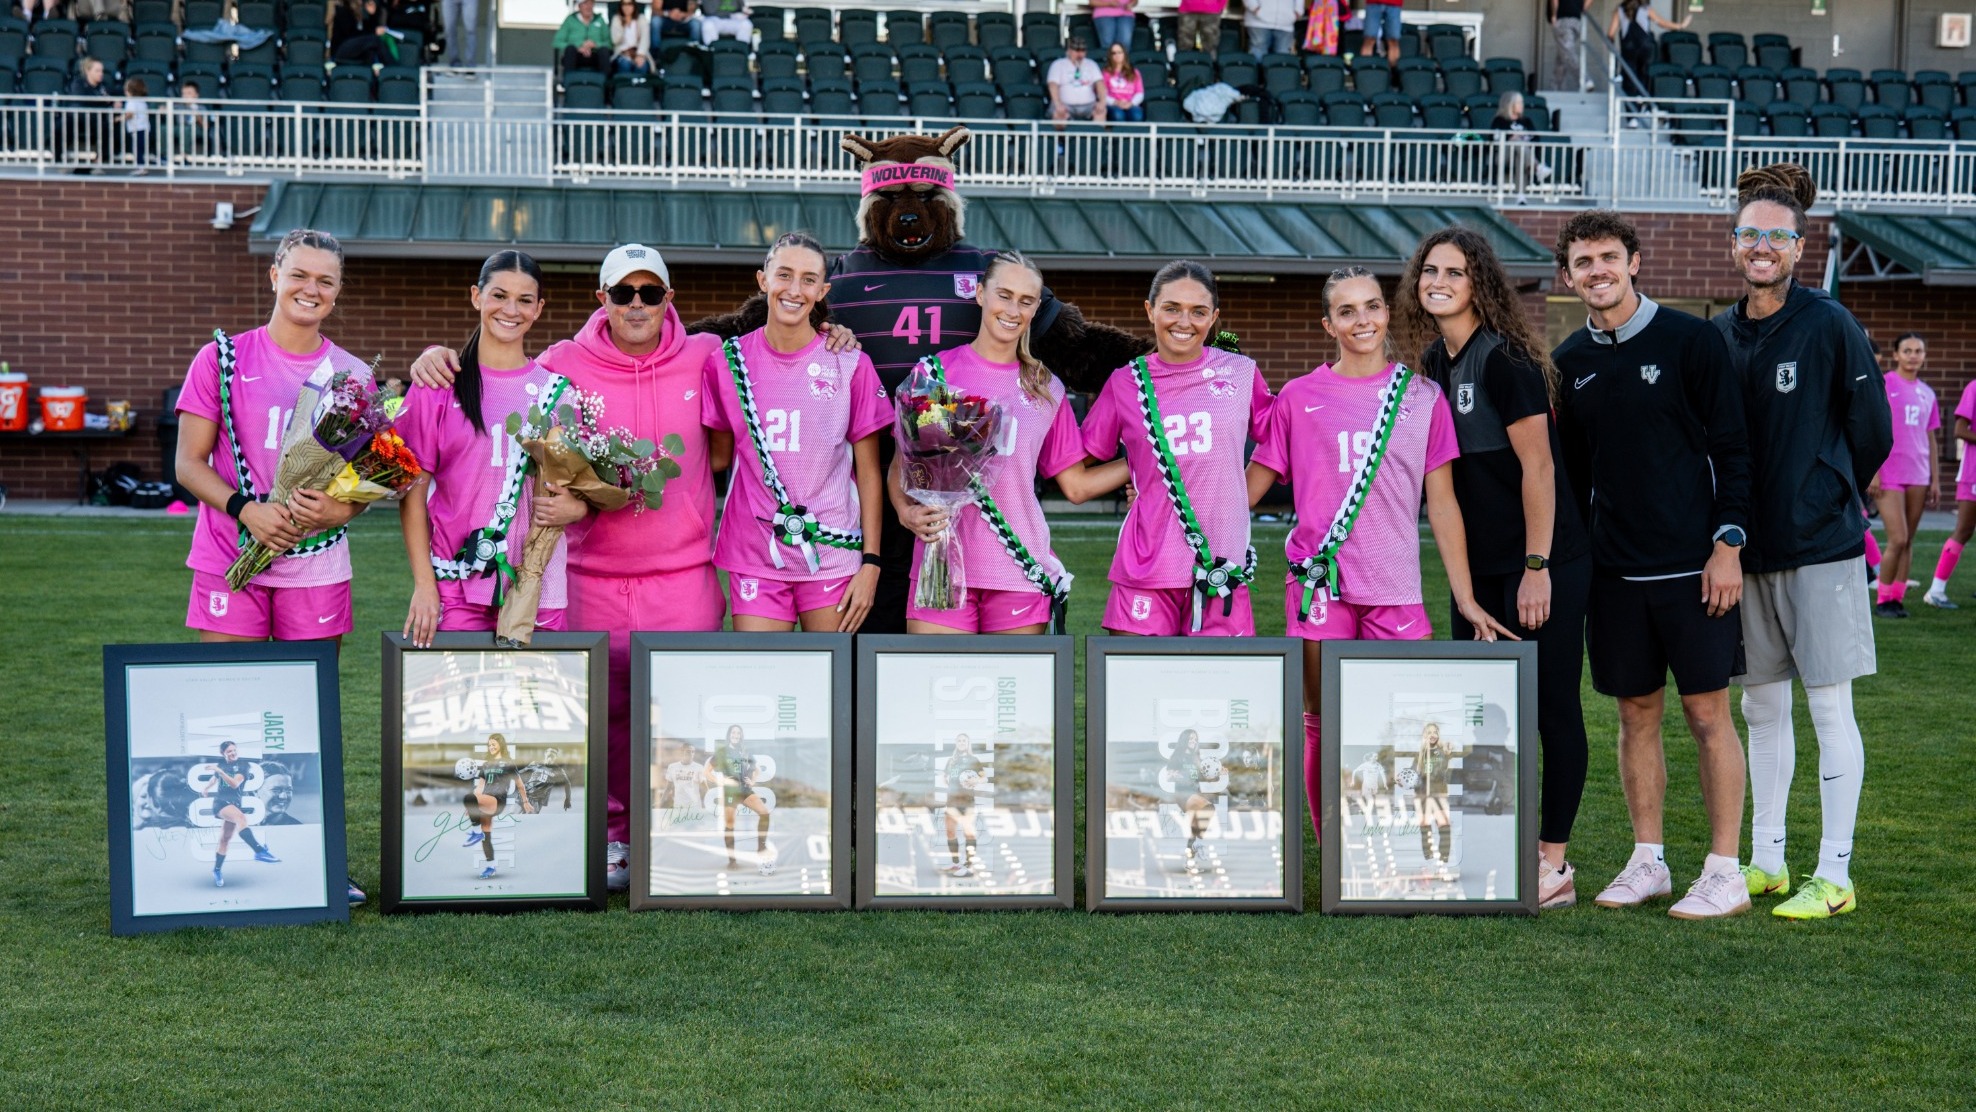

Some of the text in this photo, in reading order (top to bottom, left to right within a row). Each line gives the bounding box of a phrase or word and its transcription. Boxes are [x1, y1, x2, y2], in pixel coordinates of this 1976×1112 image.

[871, 166, 948, 184] WOLVERINE
[892, 305, 942, 345] 41
[766, 408, 801, 452] 21
[1163, 411, 1213, 456] 23
[1904, 404, 1921, 426] 12
[1337, 430, 1371, 473] 19
[777, 694, 797, 731] ADDIE
[997, 676, 1017, 734] ISABELLA
[1230, 699, 1249, 729] KATE
[1464, 693, 1484, 727] TYLIE
[263, 711, 285, 751] JACEY
